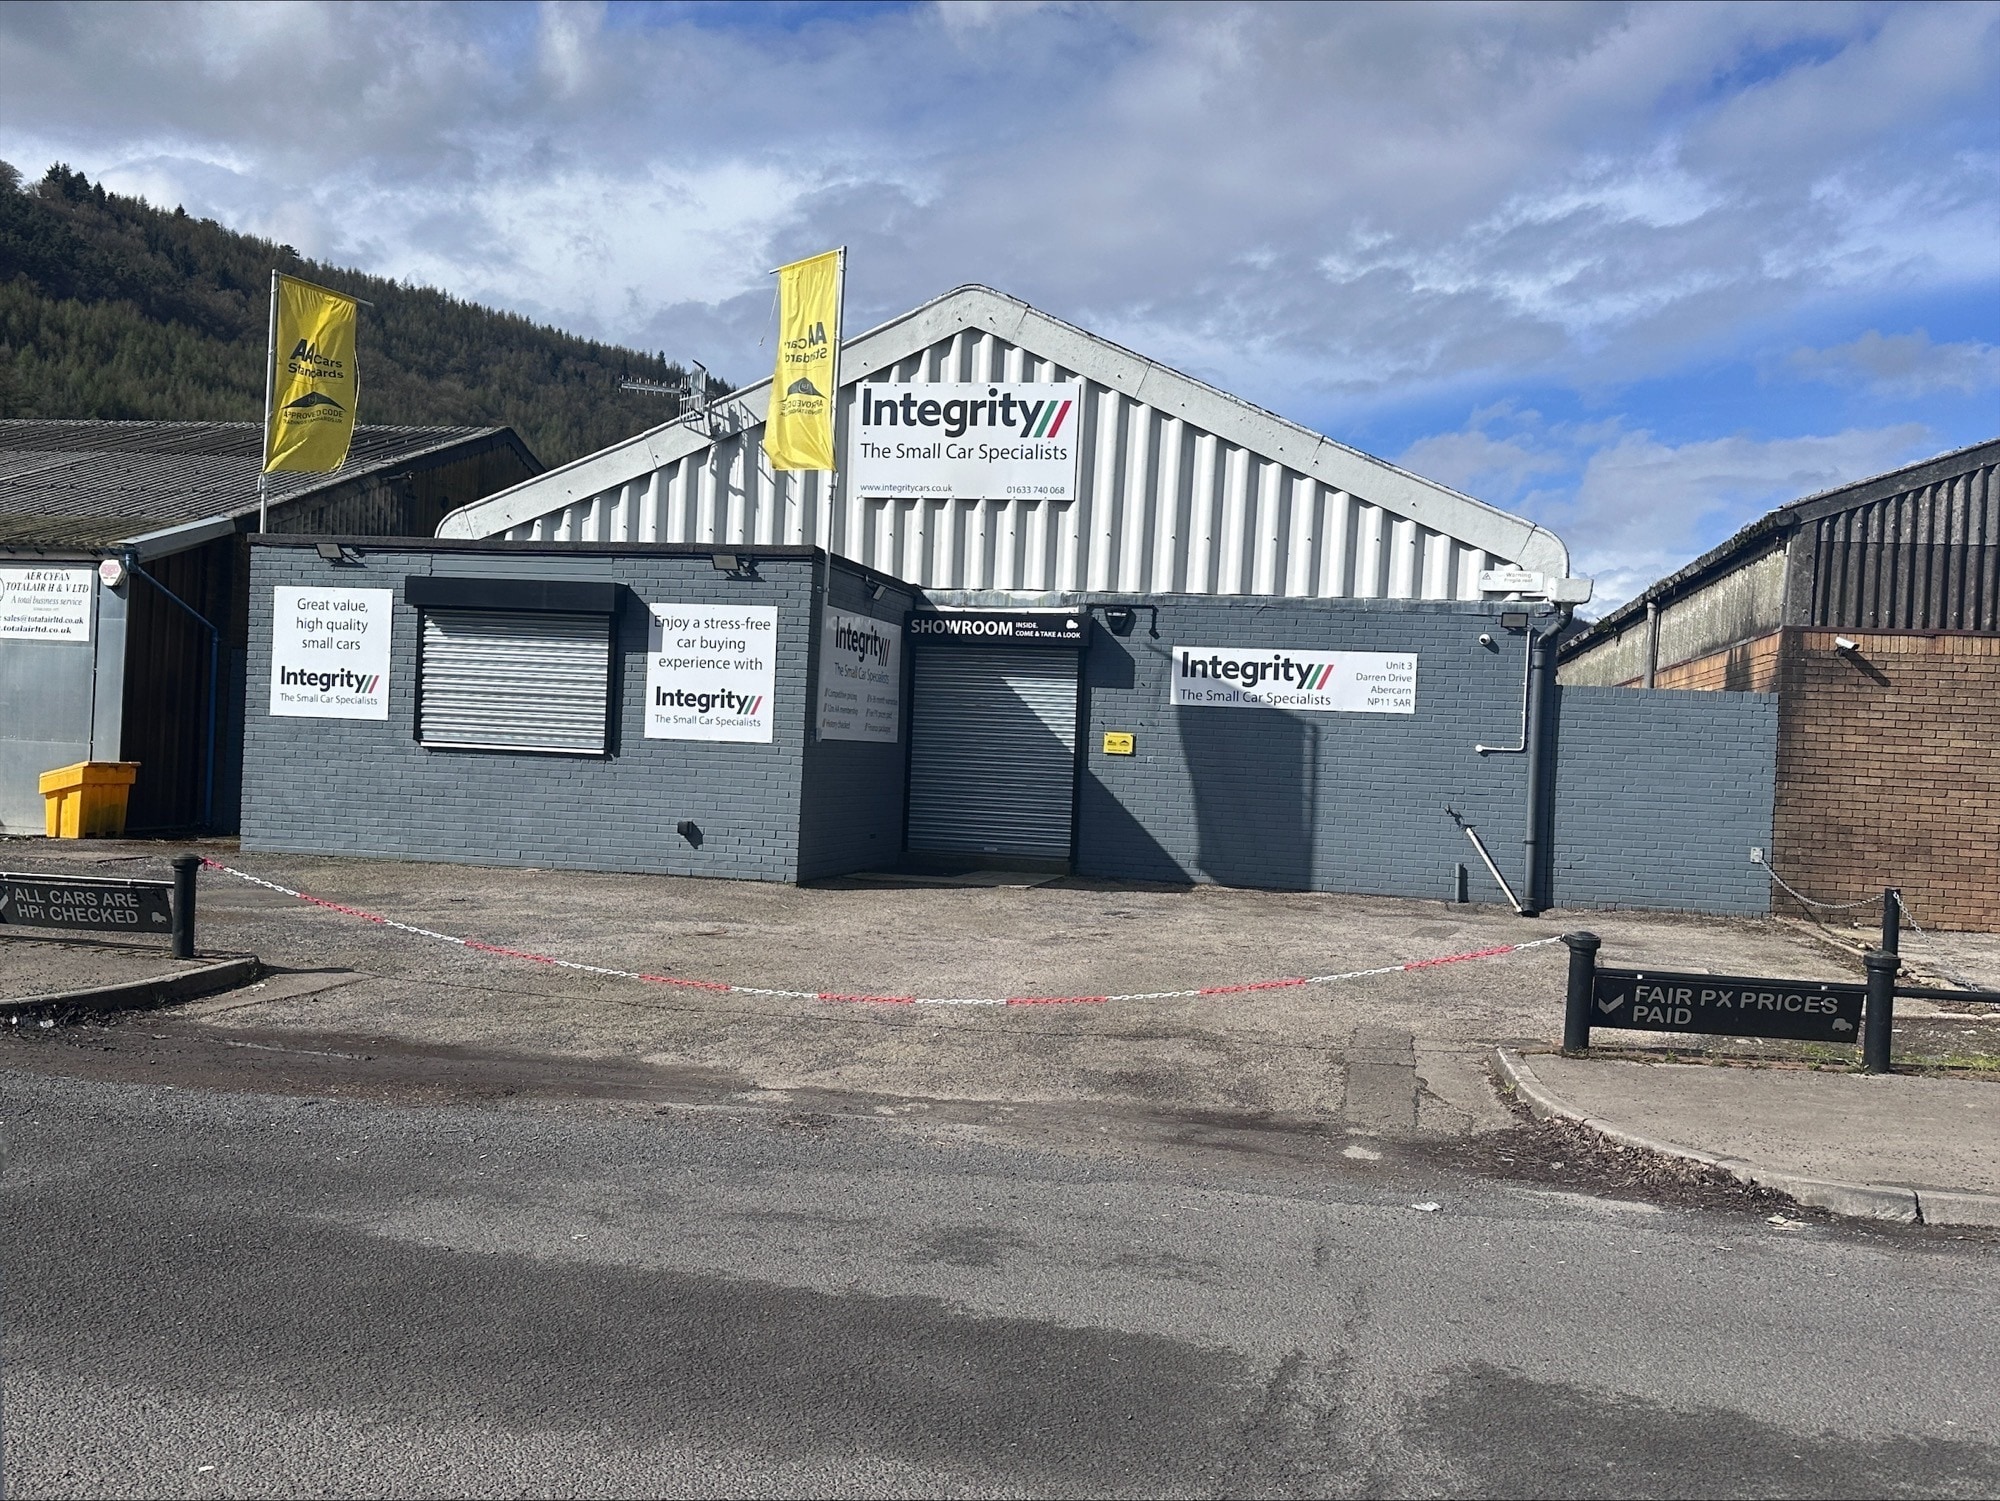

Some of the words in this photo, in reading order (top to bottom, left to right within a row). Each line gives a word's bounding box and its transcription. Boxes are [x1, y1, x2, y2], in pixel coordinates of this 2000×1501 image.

[862, 387, 1045, 438] Integrity
[860, 443, 891, 459] The
[896, 442, 941, 459] Small
[946, 444, 974, 460] Car
[978, 443, 1067, 463] Specialists
[860, 483, 953, 493] www.integritycars.co.uk
[1006, 485, 1032, 494] 01633
[1034, 485, 1049, 494] 740
[1051, 486, 1065, 495] 068
[25, 572, 42, 581] AER
[43, 572, 71, 581] CYFAN
[6, 582, 46, 592] TOTALAIR
[47, 584, 55, 592] H
[56, 584, 63, 593] &
[66, 584, 71, 593] V
[72, 584, 89, 593] LTD
[11, 596, 17, 604] A
[18, 596, 33, 604] total
[33, 596, 59, 605] business
[297, 598, 330, 611] Great
[333, 599, 369, 613] value,
[296, 616, 323, 632] high
[326, 618, 369, 634] quality
[654, 615, 690, 631] Enjoy
[692, 620, 700, 629] a
[704, 616, 771, 631] stress-free
[911, 619, 1013, 636] SHOWROOM
[302, 637, 333, 649] small
[336, 640, 361, 650] cars
[677, 638, 696, 648] car
[700, 636, 746, 653] buying
[835, 615, 885, 666] Integrity
[658, 656, 731, 671] experience
[734, 658, 763, 671] with
[834, 662, 844, 677] The
[1182, 652, 1315, 689] Integrity
[1386, 661, 1405, 670] Unit
[1407, 662, 1413, 671] 3
[281, 665, 367, 694] Integrity
[1356, 672, 1387, 682] Darren
[1388, 673, 1413, 683] Drive
[1180, 689, 1203, 701] The
[1206, 689, 1239, 702] Small
[1242, 692, 1264, 703] Car
[1266, 691, 1331, 706] Specialists
[1370, 685, 1412, 695] Abercarn
[280, 693, 295, 702] The
[296, 693, 319, 703] Small
[320, 694, 334, 703] Car
[335, 695, 378, 706] Specialists
[655, 686, 750, 715] Integrity
[1367, 697, 1391, 706] NP11
[1393, 698, 1411, 707] 5AR
[655, 714, 671, 724] The
[673, 715, 697, 724] Small
[698, 716, 714, 725] Car
[715, 716, 761, 727] Specialists
[15, 887, 46, 904] ALL
[50, 890, 98, 907] CARS
[103, 892, 140, 908] ARE
[16, 904, 45, 919] HPi
[50, 906, 139, 924] CHECKED
[1634, 985, 1693, 1006] FAIR
[1701, 989, 1734, 1008] PX
[1739, 991, 1838, 1015] PRICES
[1632, 1005, 1692, 1025] PAID
